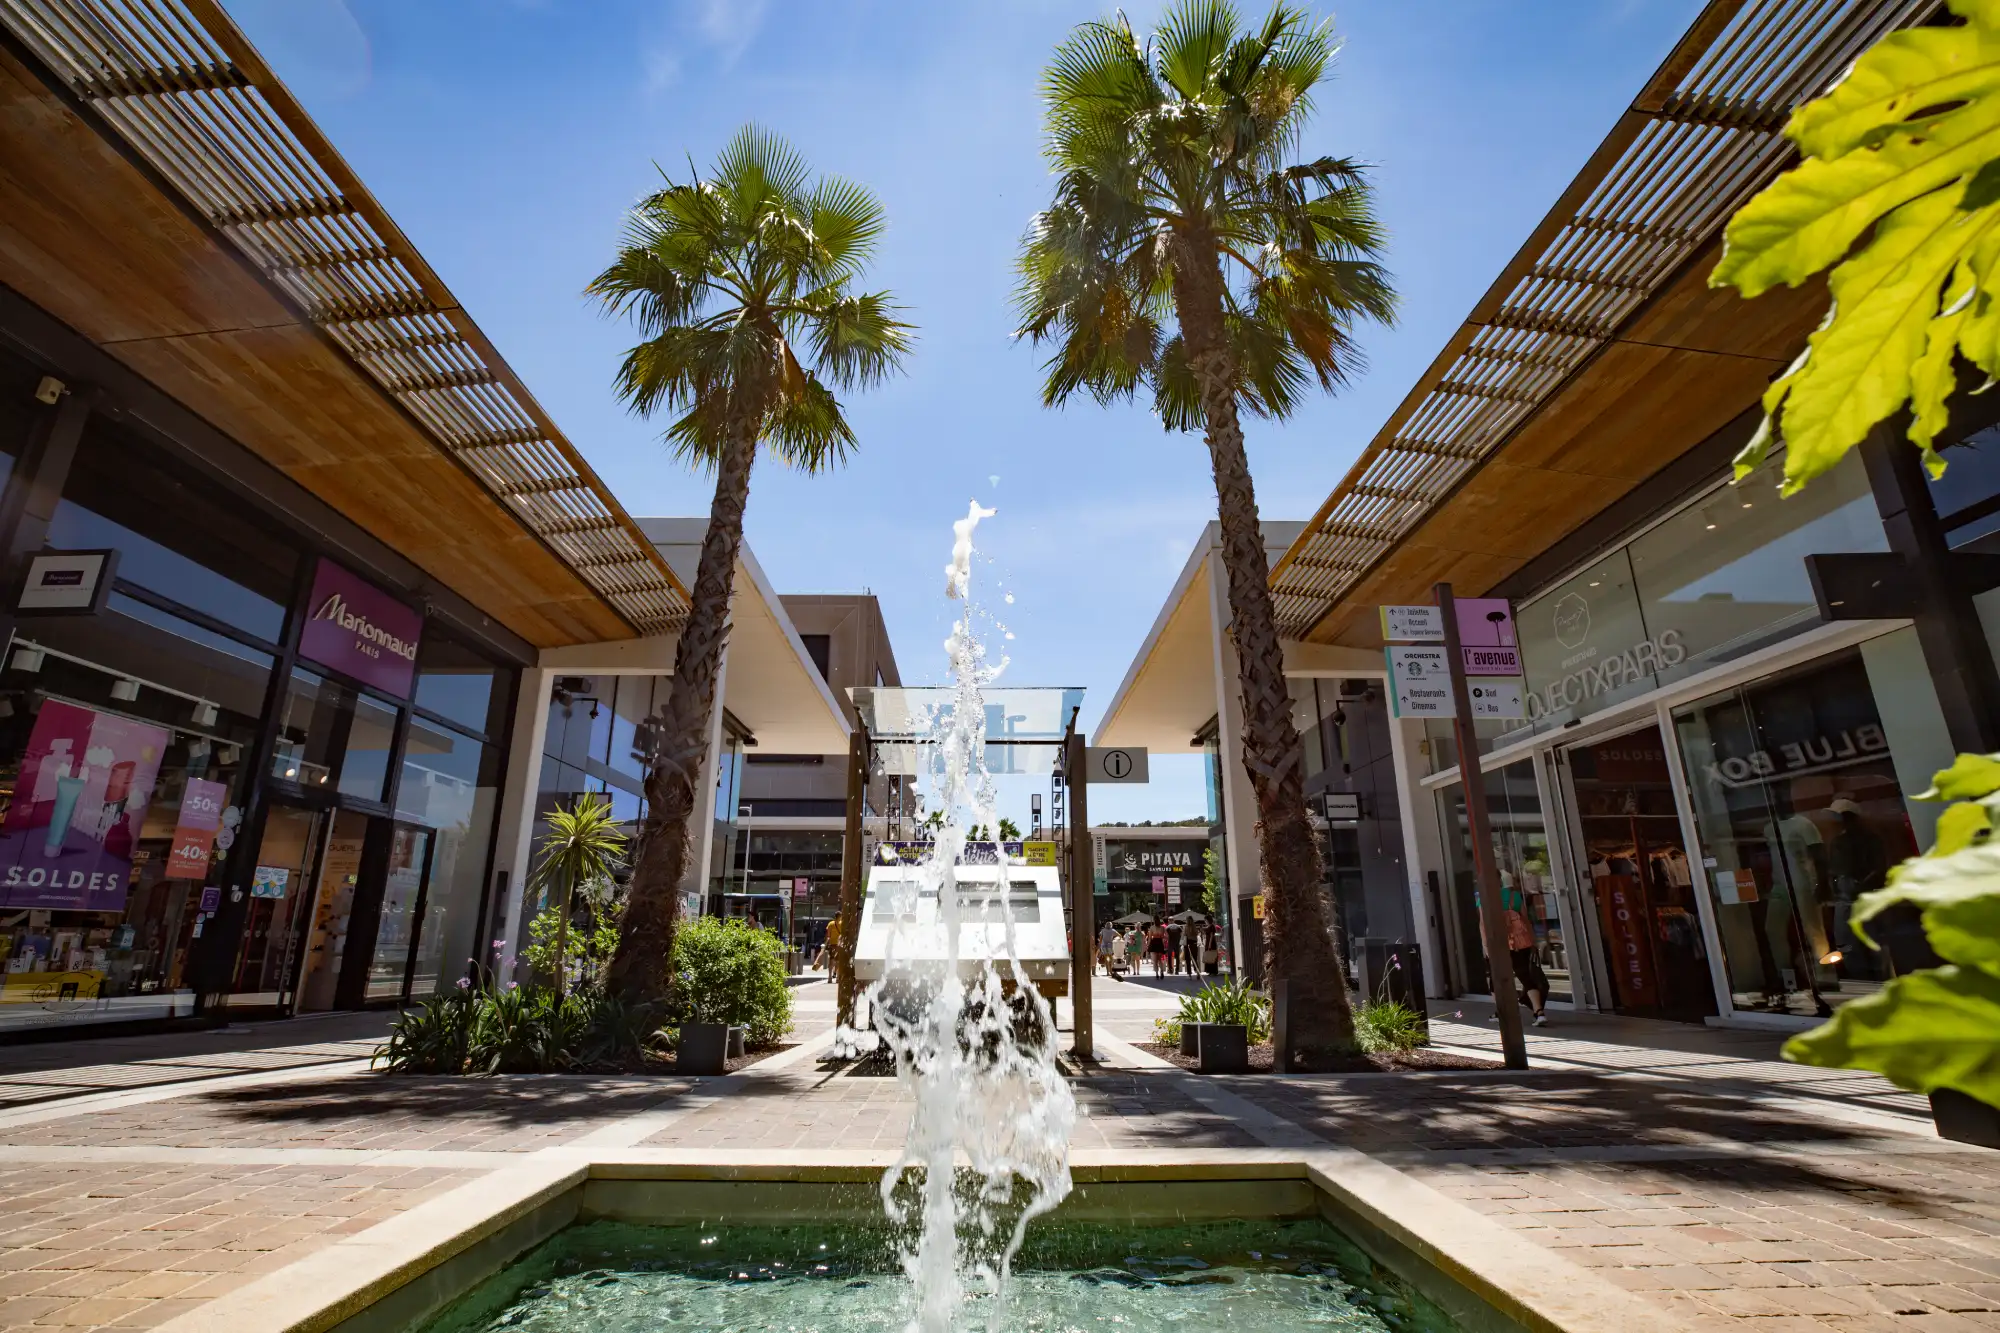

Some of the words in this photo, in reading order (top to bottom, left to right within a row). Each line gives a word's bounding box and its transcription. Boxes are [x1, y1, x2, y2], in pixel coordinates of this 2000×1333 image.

[313, 594, 418, 661] Marionnaud
[355, 641, 380, 659] PARIS
[1464, 648, 1516, 666] l'avenue
[1504, 628, 1687, 728] OJECTXPARIS
[1409, 688, 1447, 698] Restaurants
[1485, 689, 1497, 697] Sud
[1487, 703, 1499, 713] Bus
[1599, 748, 1664, 762] SOLDES
[187, 796, 219, 813] -50%
[175, 845, 208, 861] -40%
[1141, 852, 1192, 866] PITAYA
[4, 865, 119, 891] SOLDES
[1613, 890, 1644, 990] SOLDES
